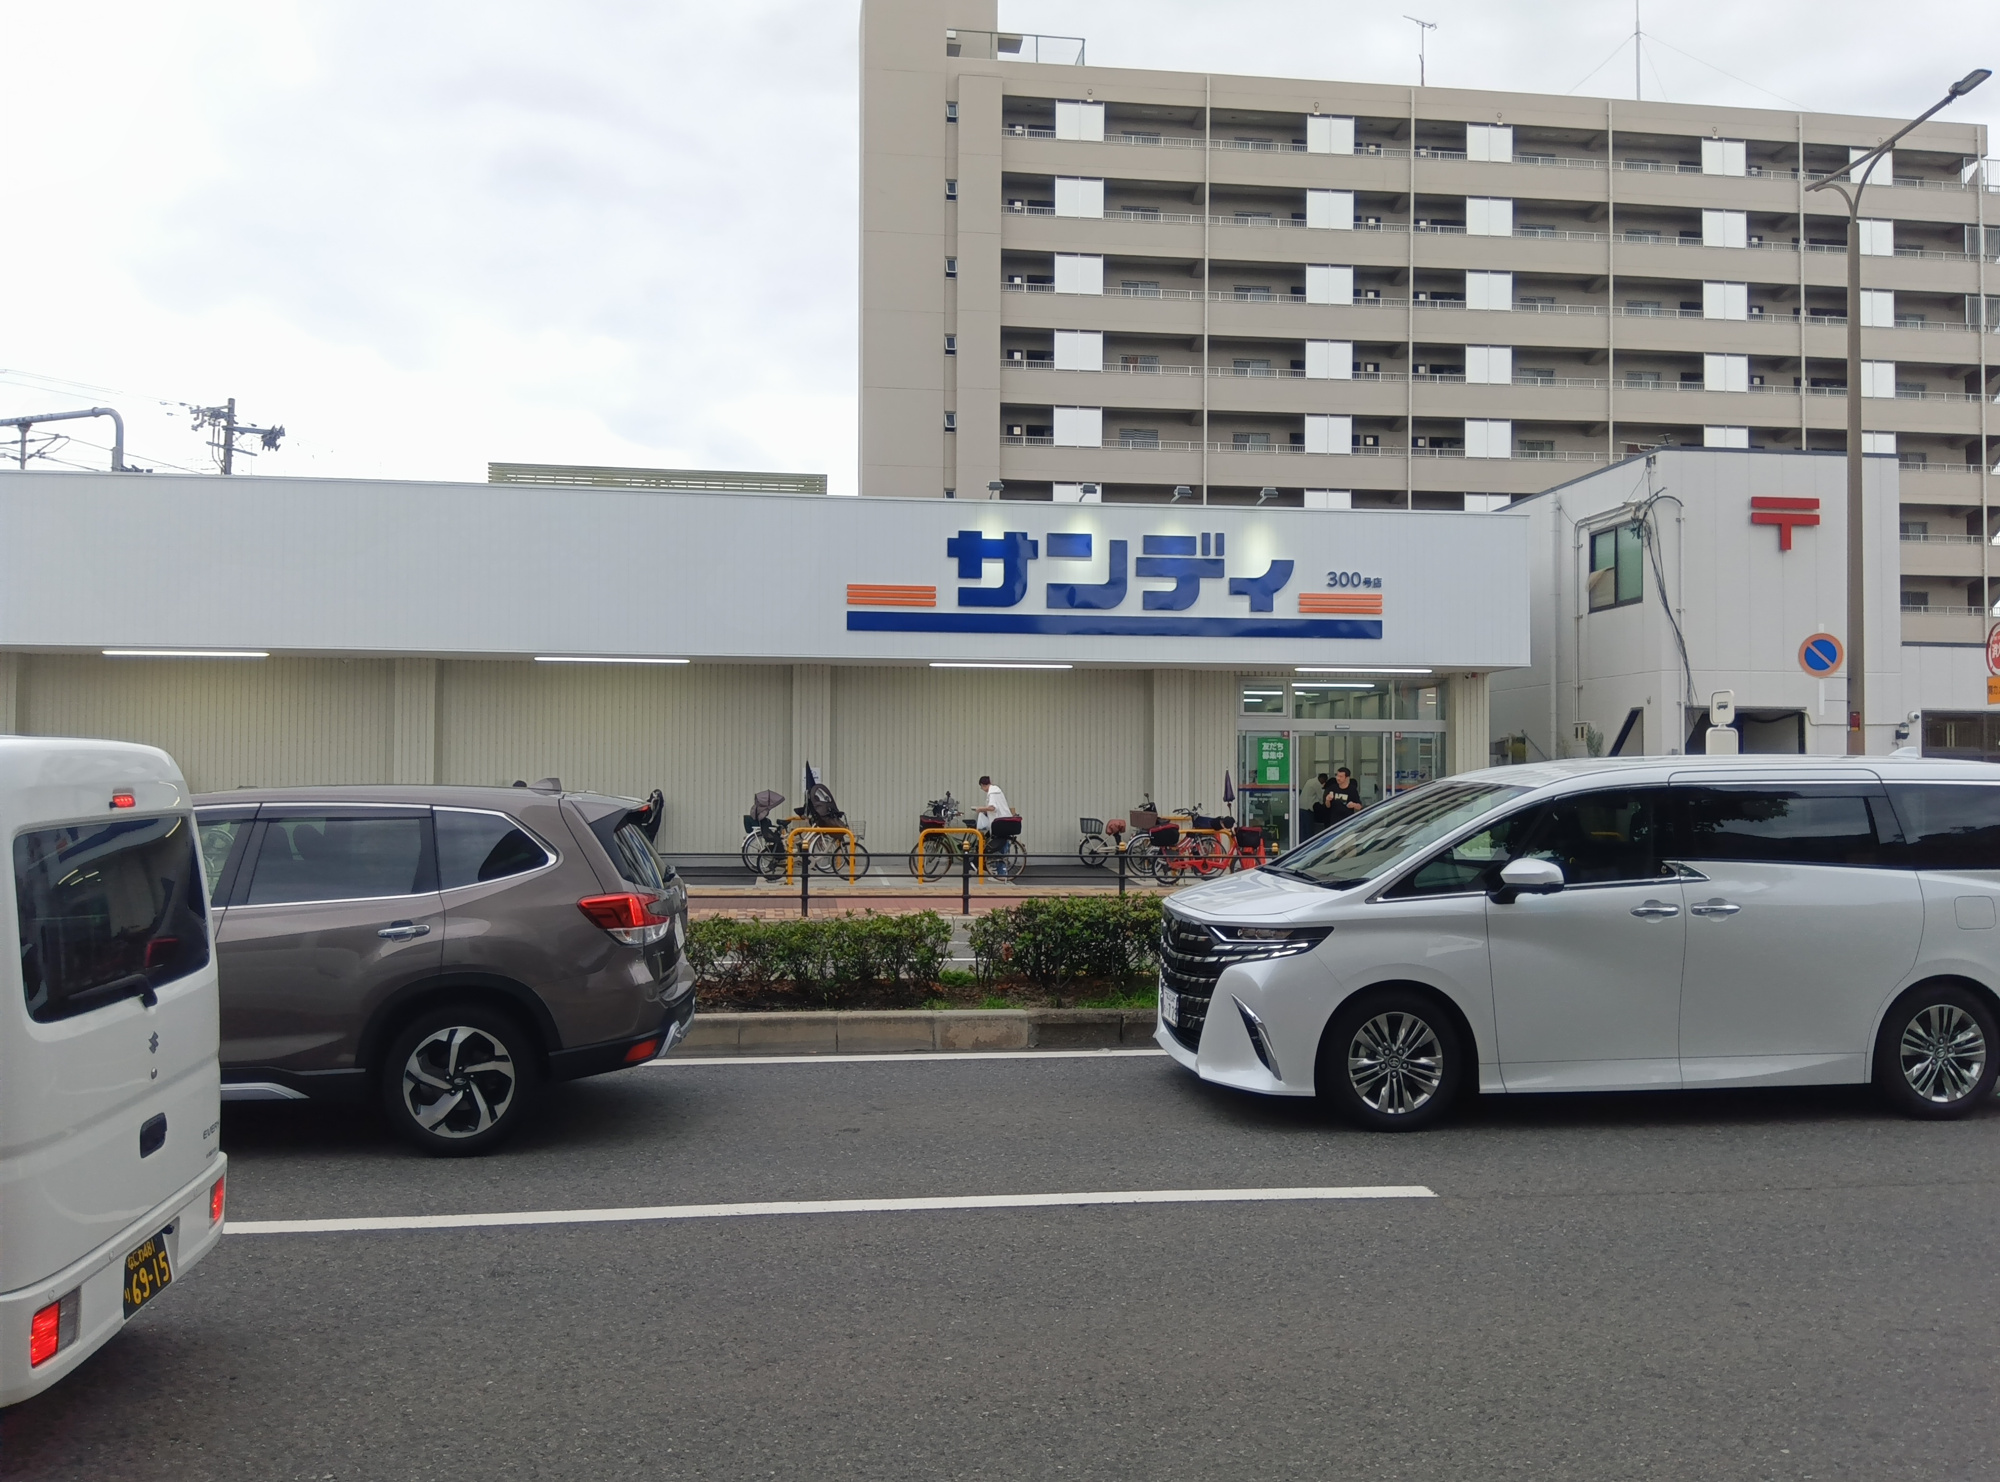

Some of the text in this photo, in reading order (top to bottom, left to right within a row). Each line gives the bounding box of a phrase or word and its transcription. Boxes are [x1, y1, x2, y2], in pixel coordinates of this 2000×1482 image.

[946, 530, 1295, 613] サンディ
[1326, 571, 1383, 588] 300号店
[1262, 742, 1284, 751] 友だち
[203, 1121, 220, 1140] EVER
[132, 1250, 170, 1305] 69-15
